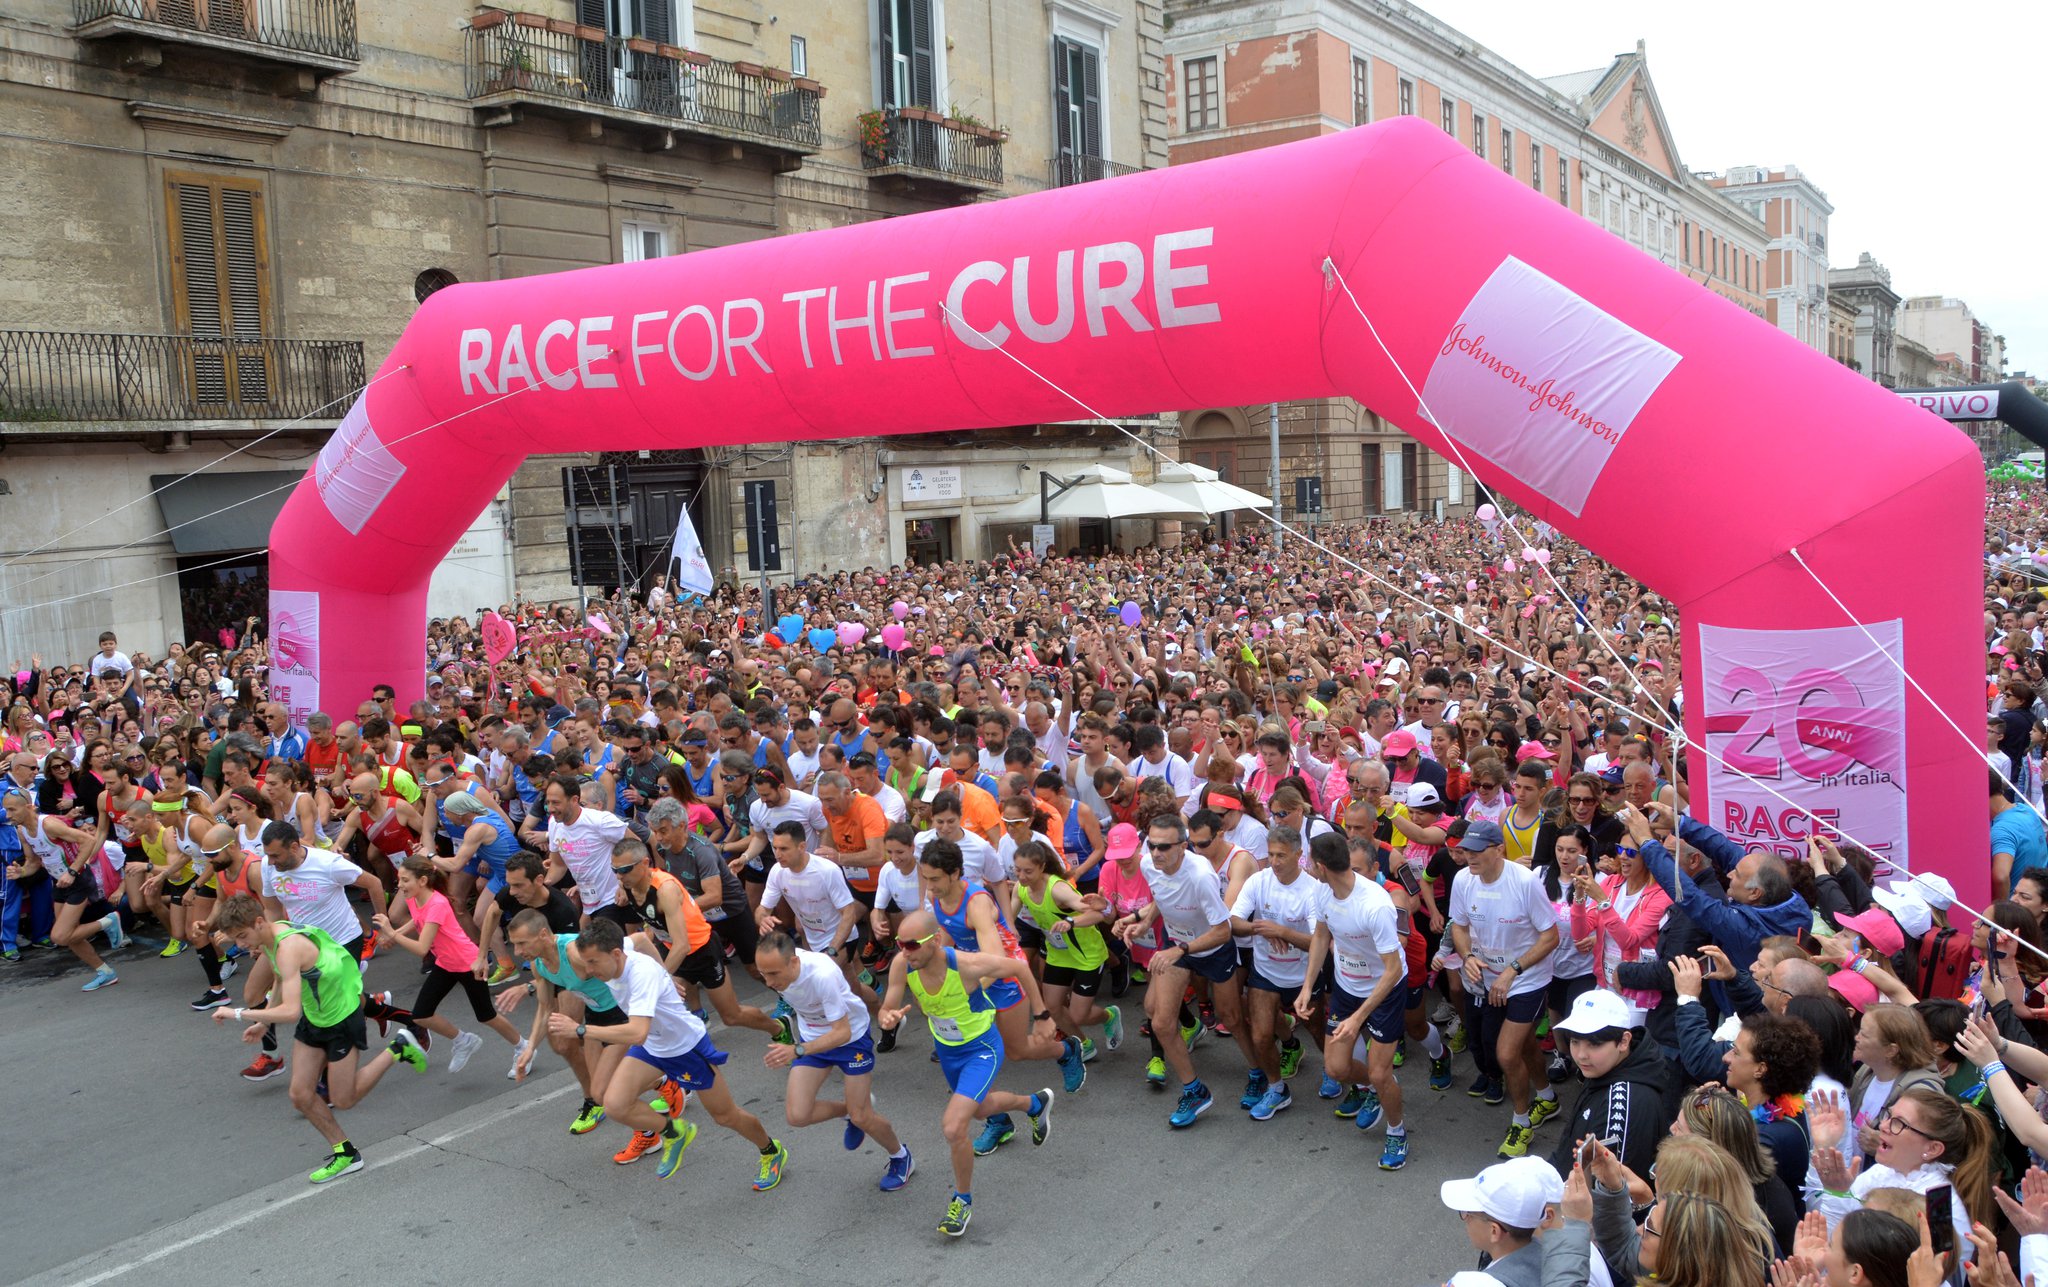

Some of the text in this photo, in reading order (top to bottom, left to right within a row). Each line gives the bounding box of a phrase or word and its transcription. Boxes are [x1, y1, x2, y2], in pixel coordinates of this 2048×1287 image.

[459, 226, 1222, 396] RACE FOR THE CURE
[269, 684, 291, 704] ACE
[1719, 666, 1865, 783] 20
[1809, 724, 1854, 744] ANNI
[1821, 768, 1892, 788] in Italia
[1724, 799, 1840, 843] RACE
